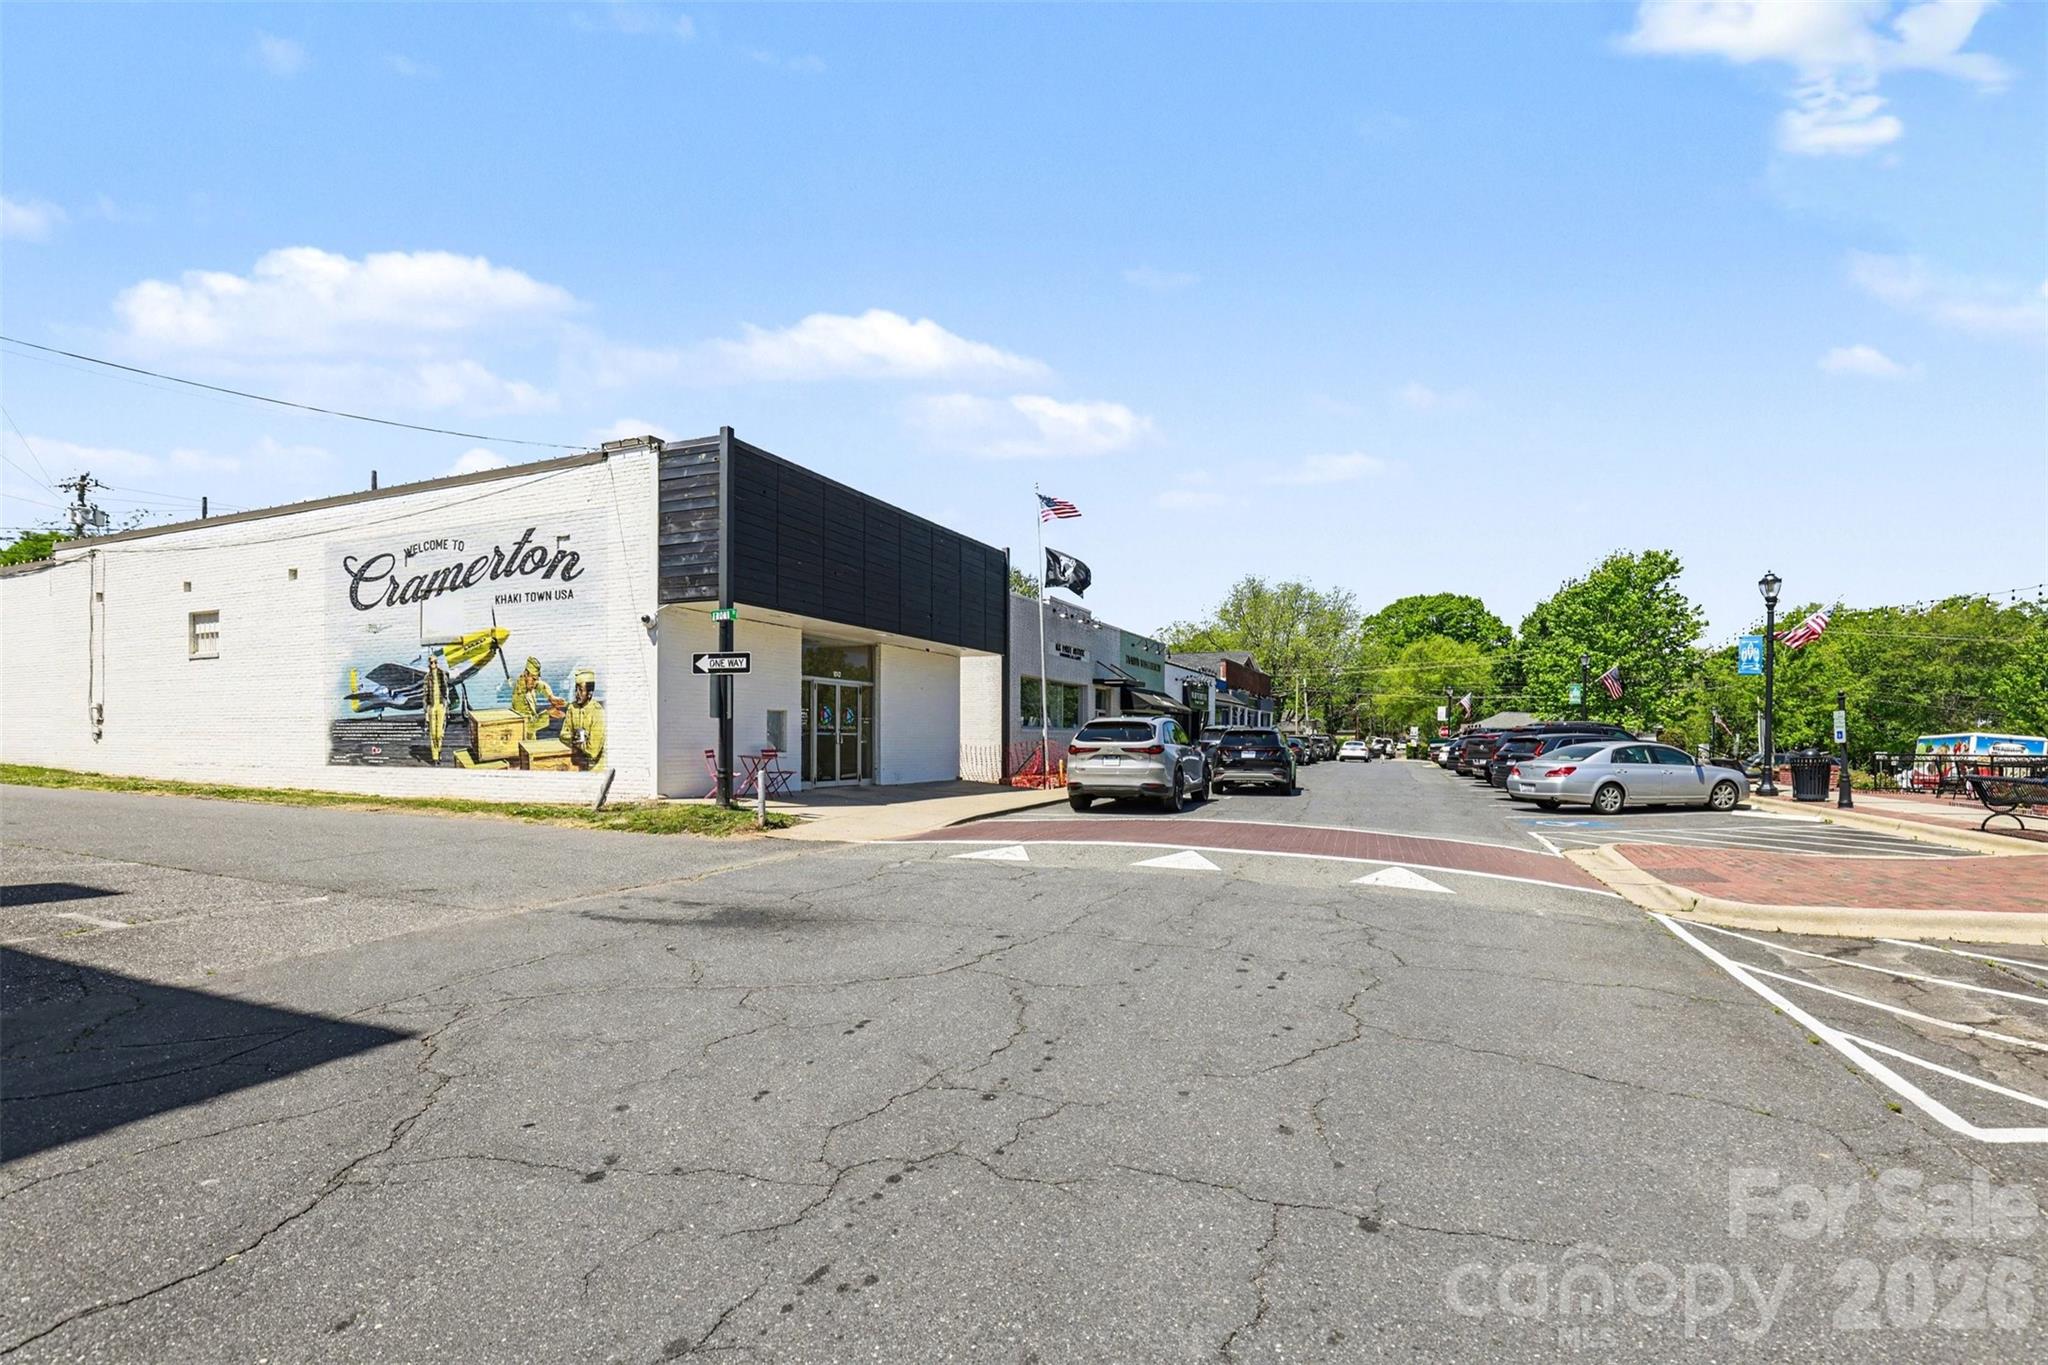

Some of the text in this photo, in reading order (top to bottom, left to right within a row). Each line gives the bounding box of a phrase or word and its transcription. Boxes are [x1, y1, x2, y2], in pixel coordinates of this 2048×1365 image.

[404, 539, 465, 558] WELCOME TO
[343, 528, 585, 611] Cramerton
[494, 589, 574, 605] KHAKI TOWN USA
[710, 659, 744, 667] ONE WAY
